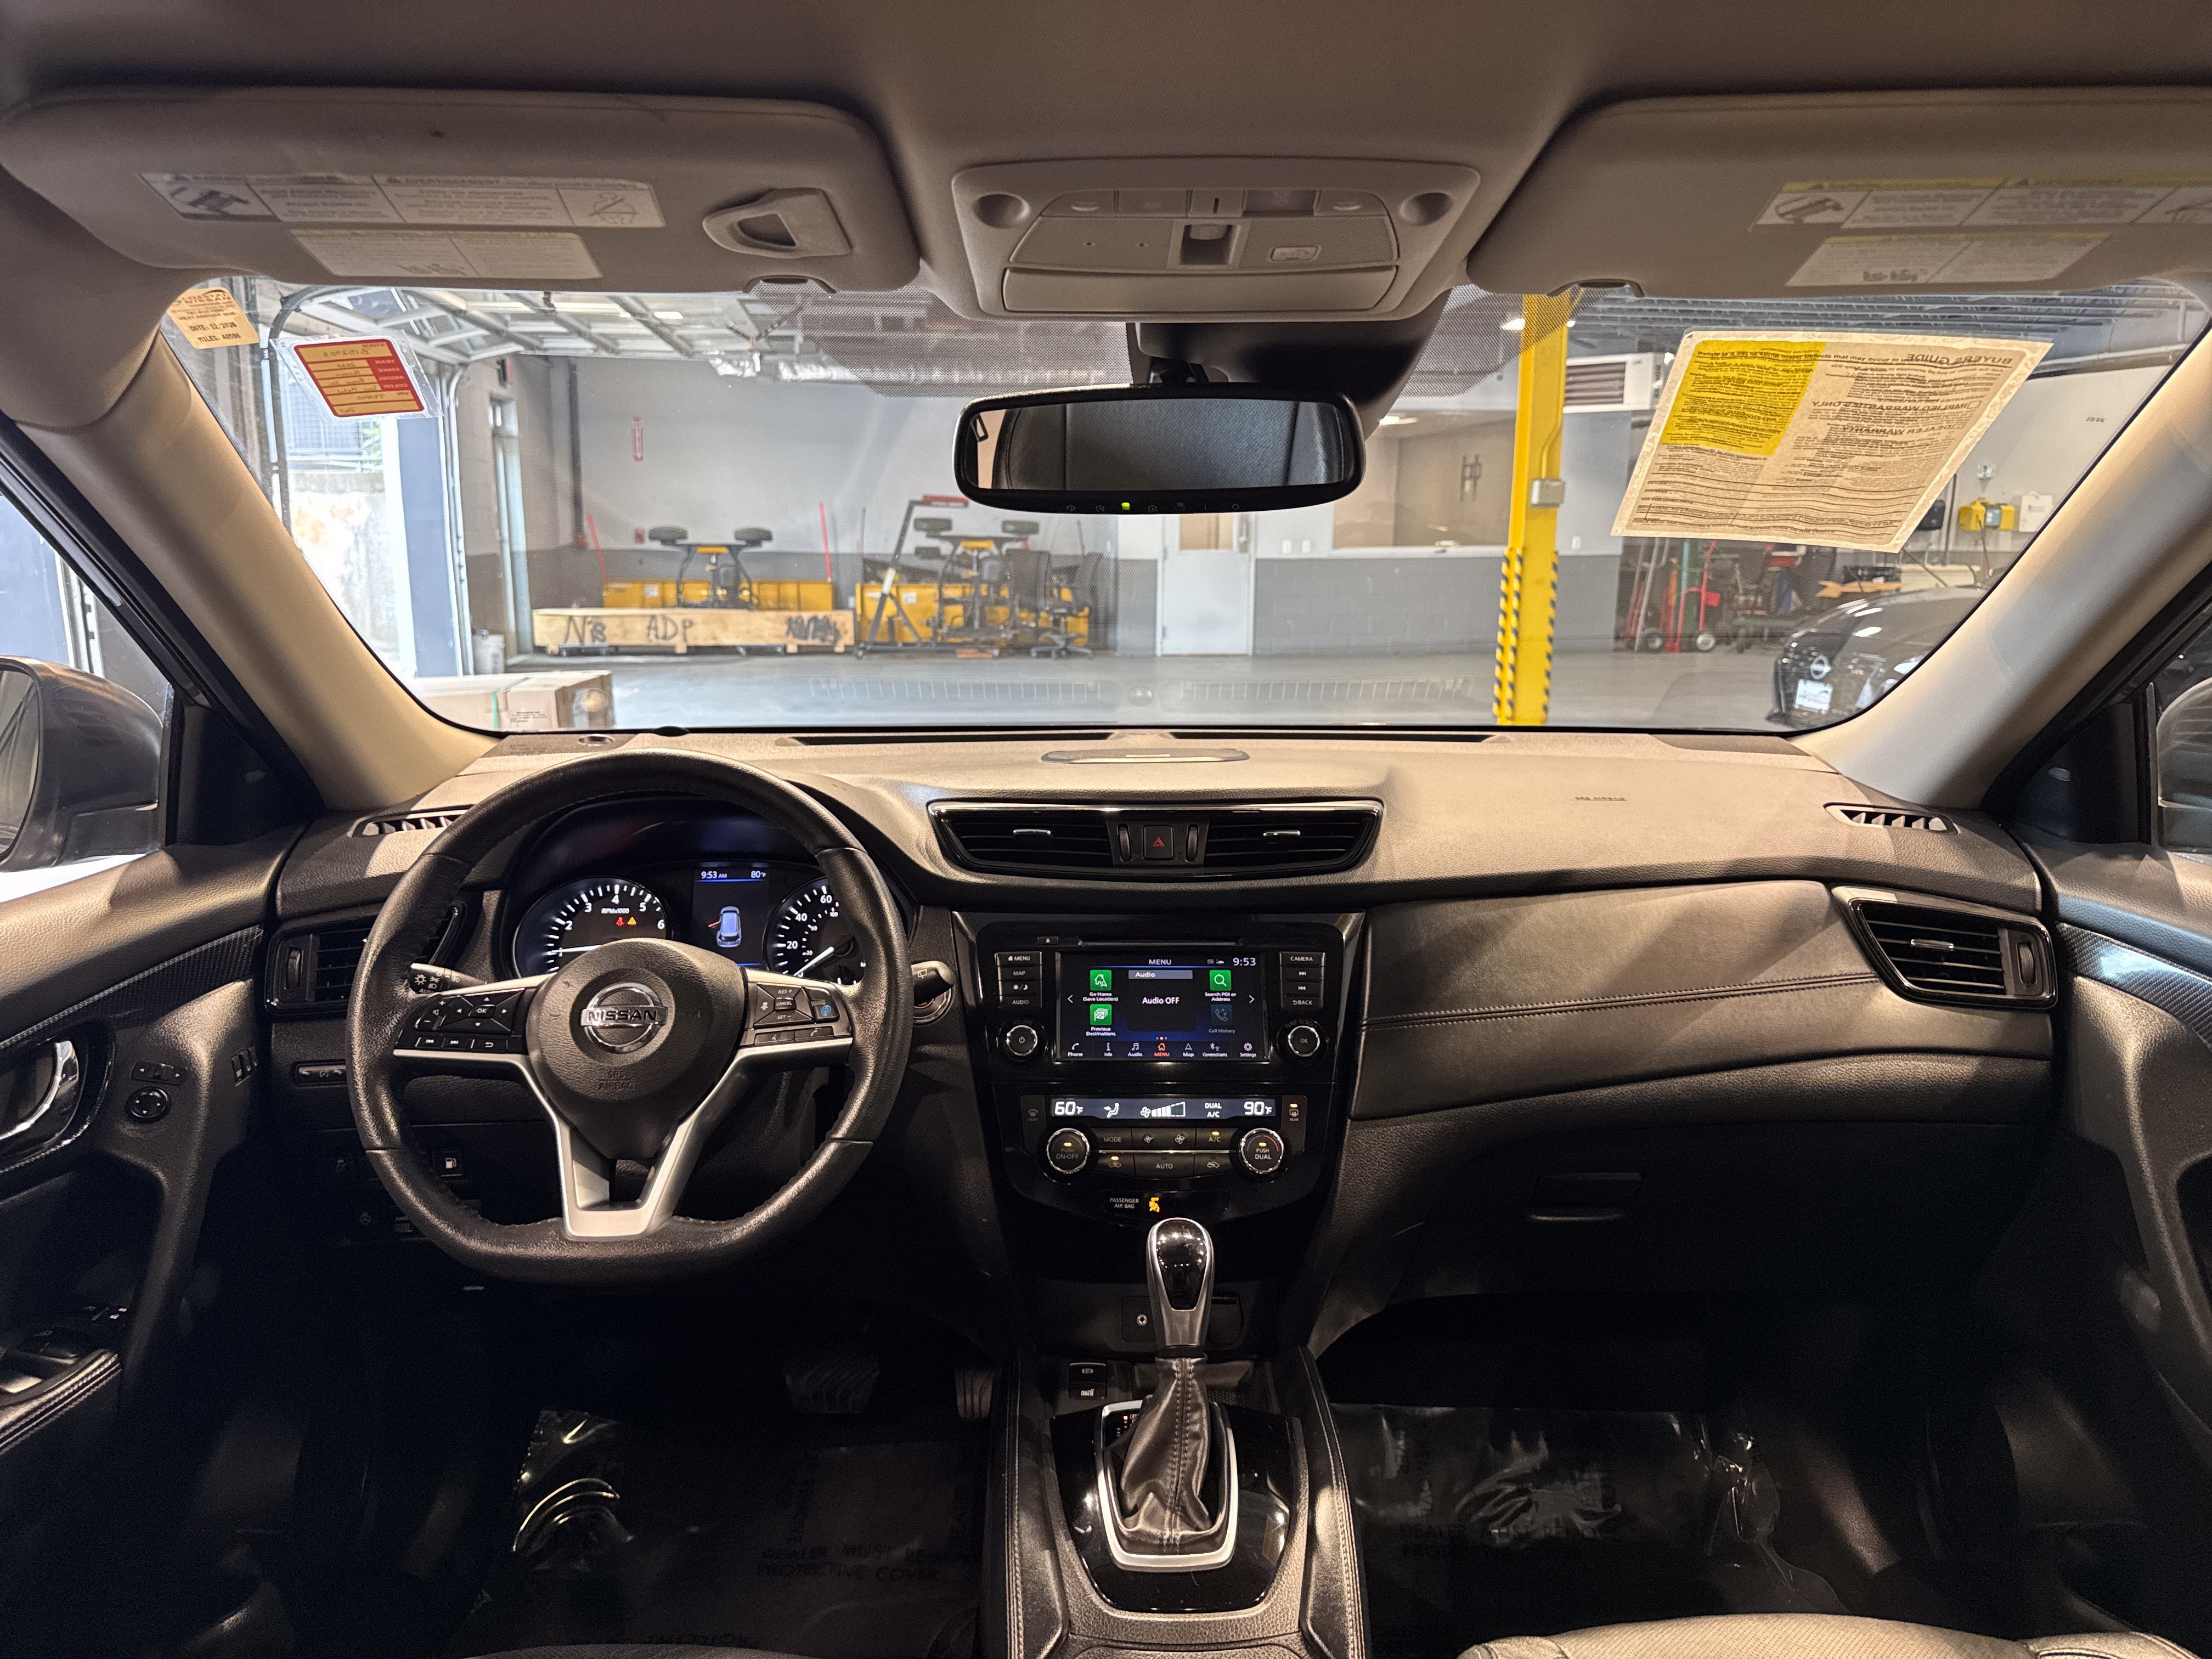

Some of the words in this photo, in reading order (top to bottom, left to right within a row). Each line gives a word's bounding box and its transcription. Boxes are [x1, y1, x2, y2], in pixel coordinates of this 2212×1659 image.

[185, 296, 231, 304] NISSAN
[701, 871, 717, 879] 9:53
[611, 894, 619, 904] 4
[820, 895, 832, 904] 60
[584, 902, 592, 913] 3
[639, 902, 646, 912] 5
[795, 912, 808, 922] 40
[565, 921, 573, 930] 2
[657, 919, 665, 929] 6
[786, 940, 798, 949] 20
[1233, 957, 1256, 966] 9:53
[587, 1009, 658, 1022] NISSAN
[598, 1081, 635, 1090] AIRBAG
